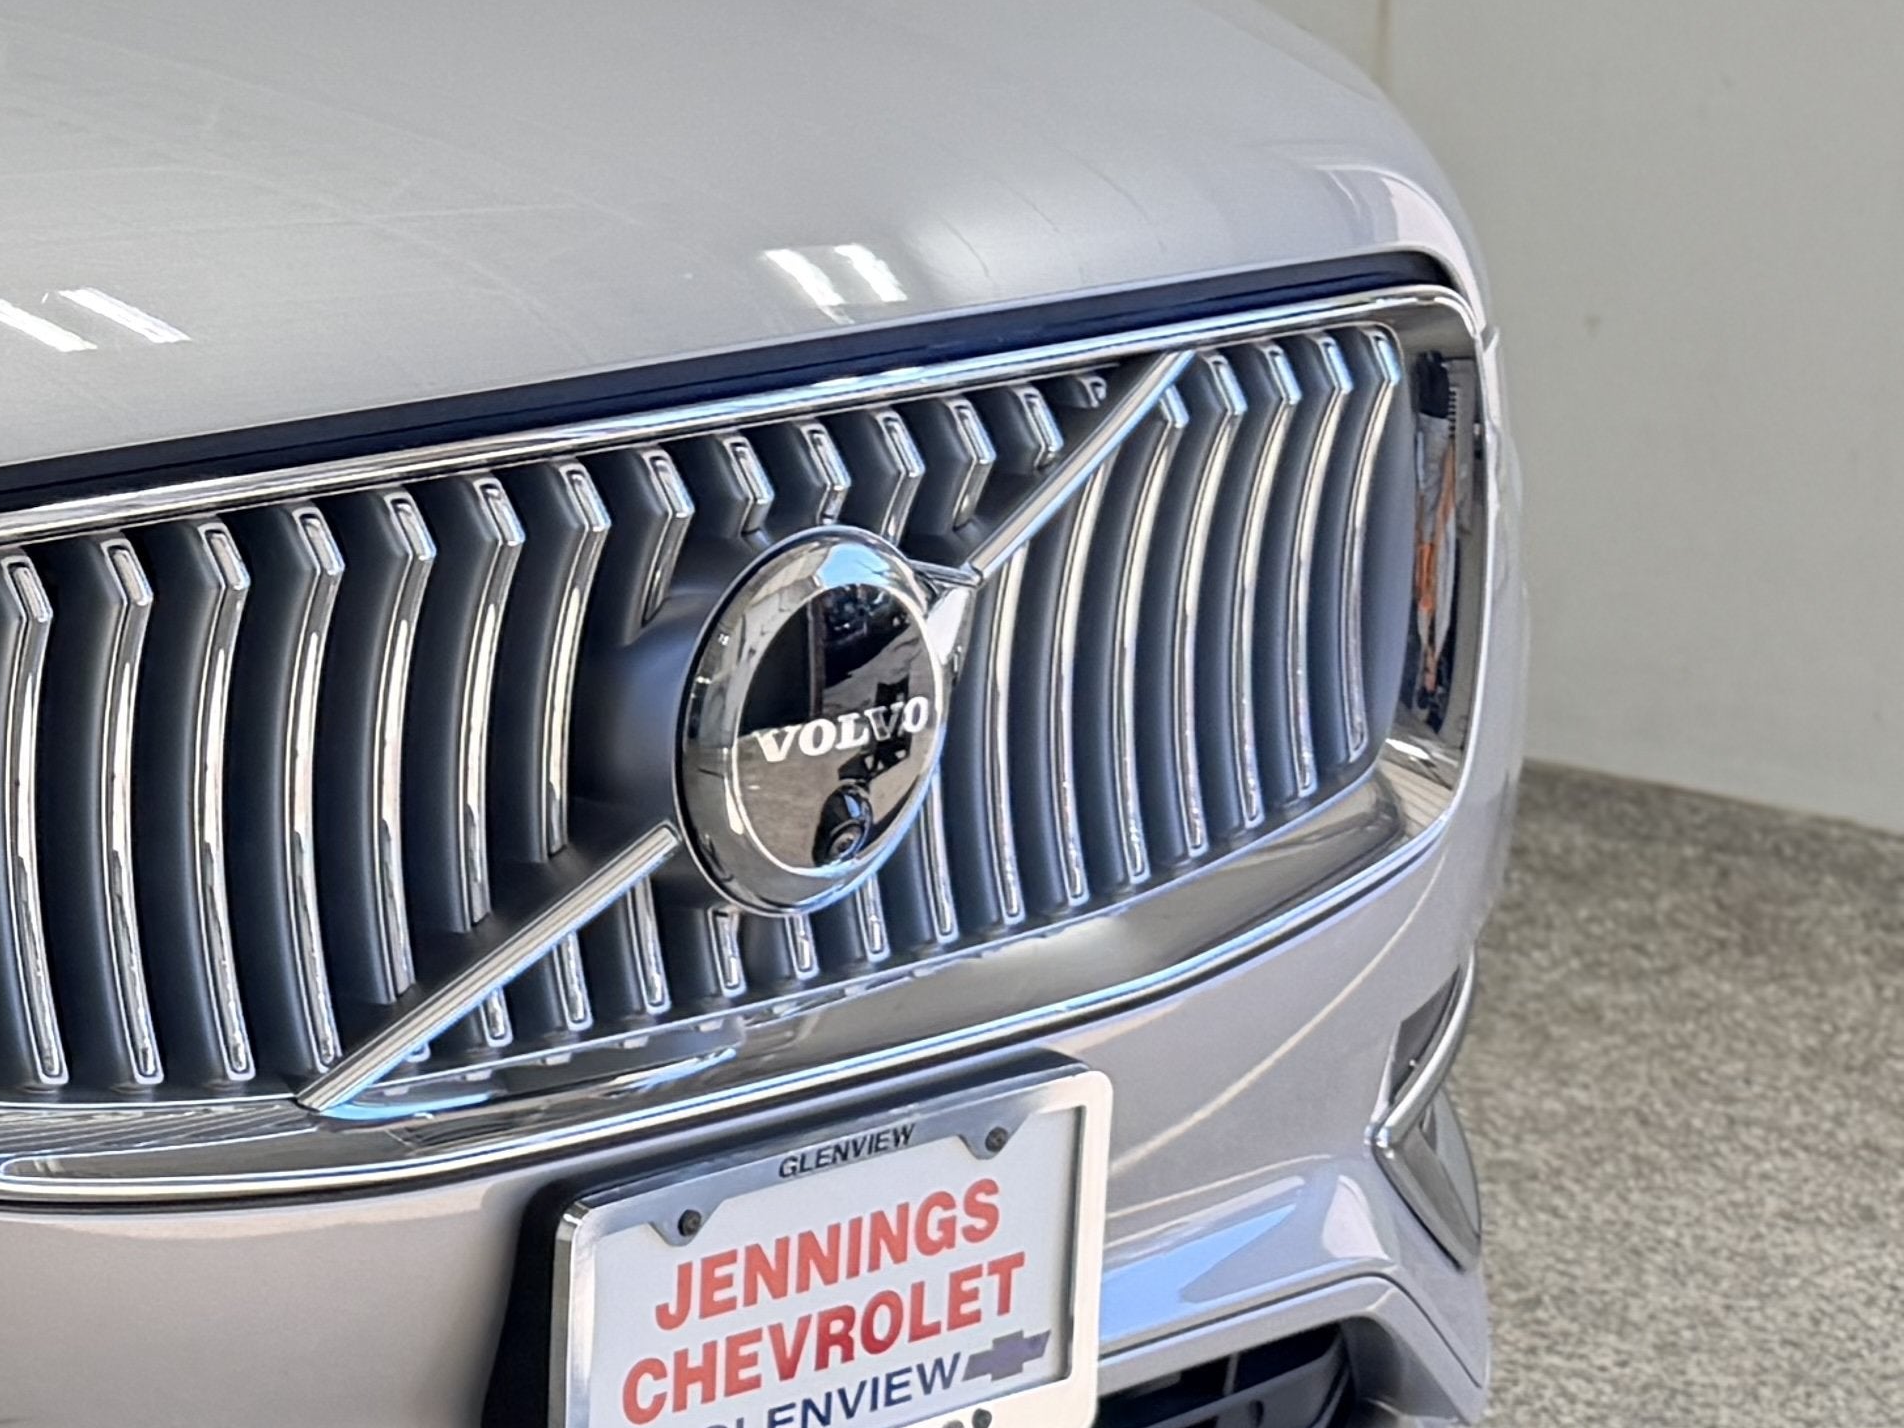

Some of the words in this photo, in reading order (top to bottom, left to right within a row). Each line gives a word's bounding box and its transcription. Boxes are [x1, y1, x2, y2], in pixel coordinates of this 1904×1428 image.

[753, 695, 929, 763] VOLVO
[778, 1122, 916, 1178] GLENVIEW
[655, 1178, 1001, 1331] JENNINGS
[621, 1251, 1025, 1425] CHEVROLET
